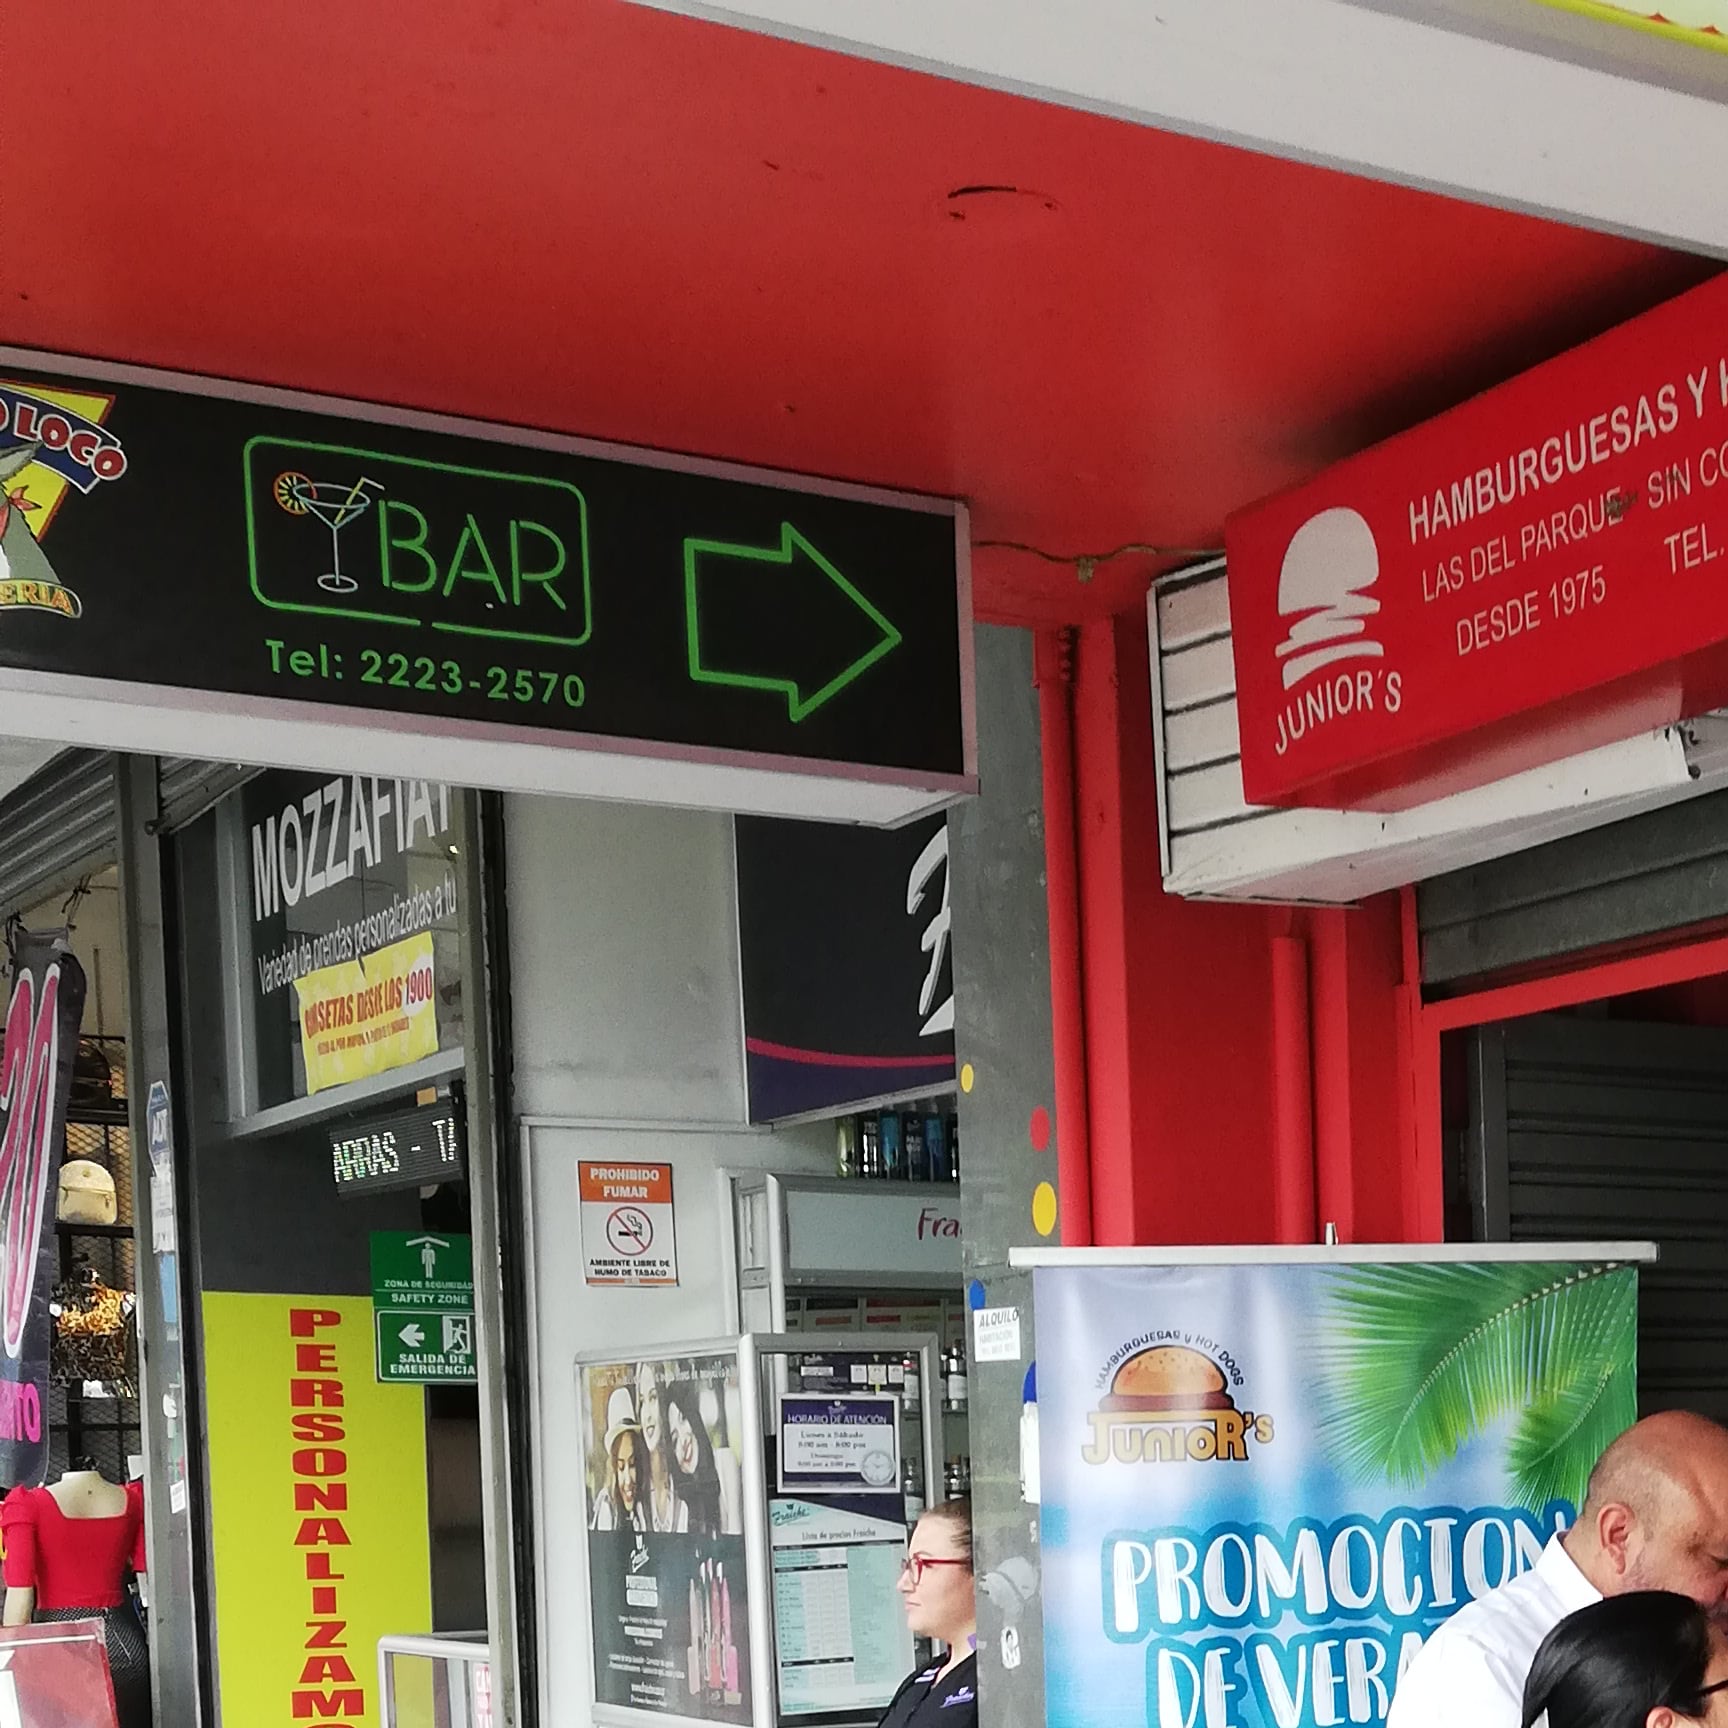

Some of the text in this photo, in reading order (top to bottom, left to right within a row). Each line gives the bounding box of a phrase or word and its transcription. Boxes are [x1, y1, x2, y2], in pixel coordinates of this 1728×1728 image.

[14, 402, 128, 480] LOCO
[1408, 384, 1679, 545] HAMBURGUESAS
[1686, 366, 1708, 418] Y
[1421, 562, 1464, 603] LAS
[1470, 538, 1516, 583] DEL
[1520, 487, 1622, 566] PARQUE
[1647, 466, 1692, 510] SIN
[1664, 525, 1726, 576] TEL.
[377, 499, 568, 611] BAR
[1455, 564, 1606, 657] DESDE 1975
[266, 639, 587, 710] Tel: 2223-2570
[258, 939, 299, 995] Variedad
[354, 883, 432, 956] personalizadas
[435, 886, 443, 919] a
[444, 871, 457, 915] tu
[384, 976, 402, 1013] LOS
[405, 966, 433, 1005] 1900
[590, 1167, 660, 1182] PROHIBIDO
[603, 1185, 648, 1199] FUMAR
[917, 1207, 962, 1240] Fra
[589, 1258, 670, 1267] AMBIENTE LIBRE DE
[594, 1268, 667, 1277] HUMO DE TABACO
[384, 1279, 474, 1290] ZONA DE SEGURIDAD
[391, 1293, 469, 1305] SAFETY ZONE
[979, 1307, 1019, 1328] ALQUILO
[390, 1364, 476, 1376] EMERGENCIA
[399, 1353, 466, 1365] SALIDA DE
[1195, 1334, 1220, 1353] HOT
[1218, 1350, 1245, 1387] DOGS
[787, 1413, 887, 1425] HORARIO DE ATENCIÓN
